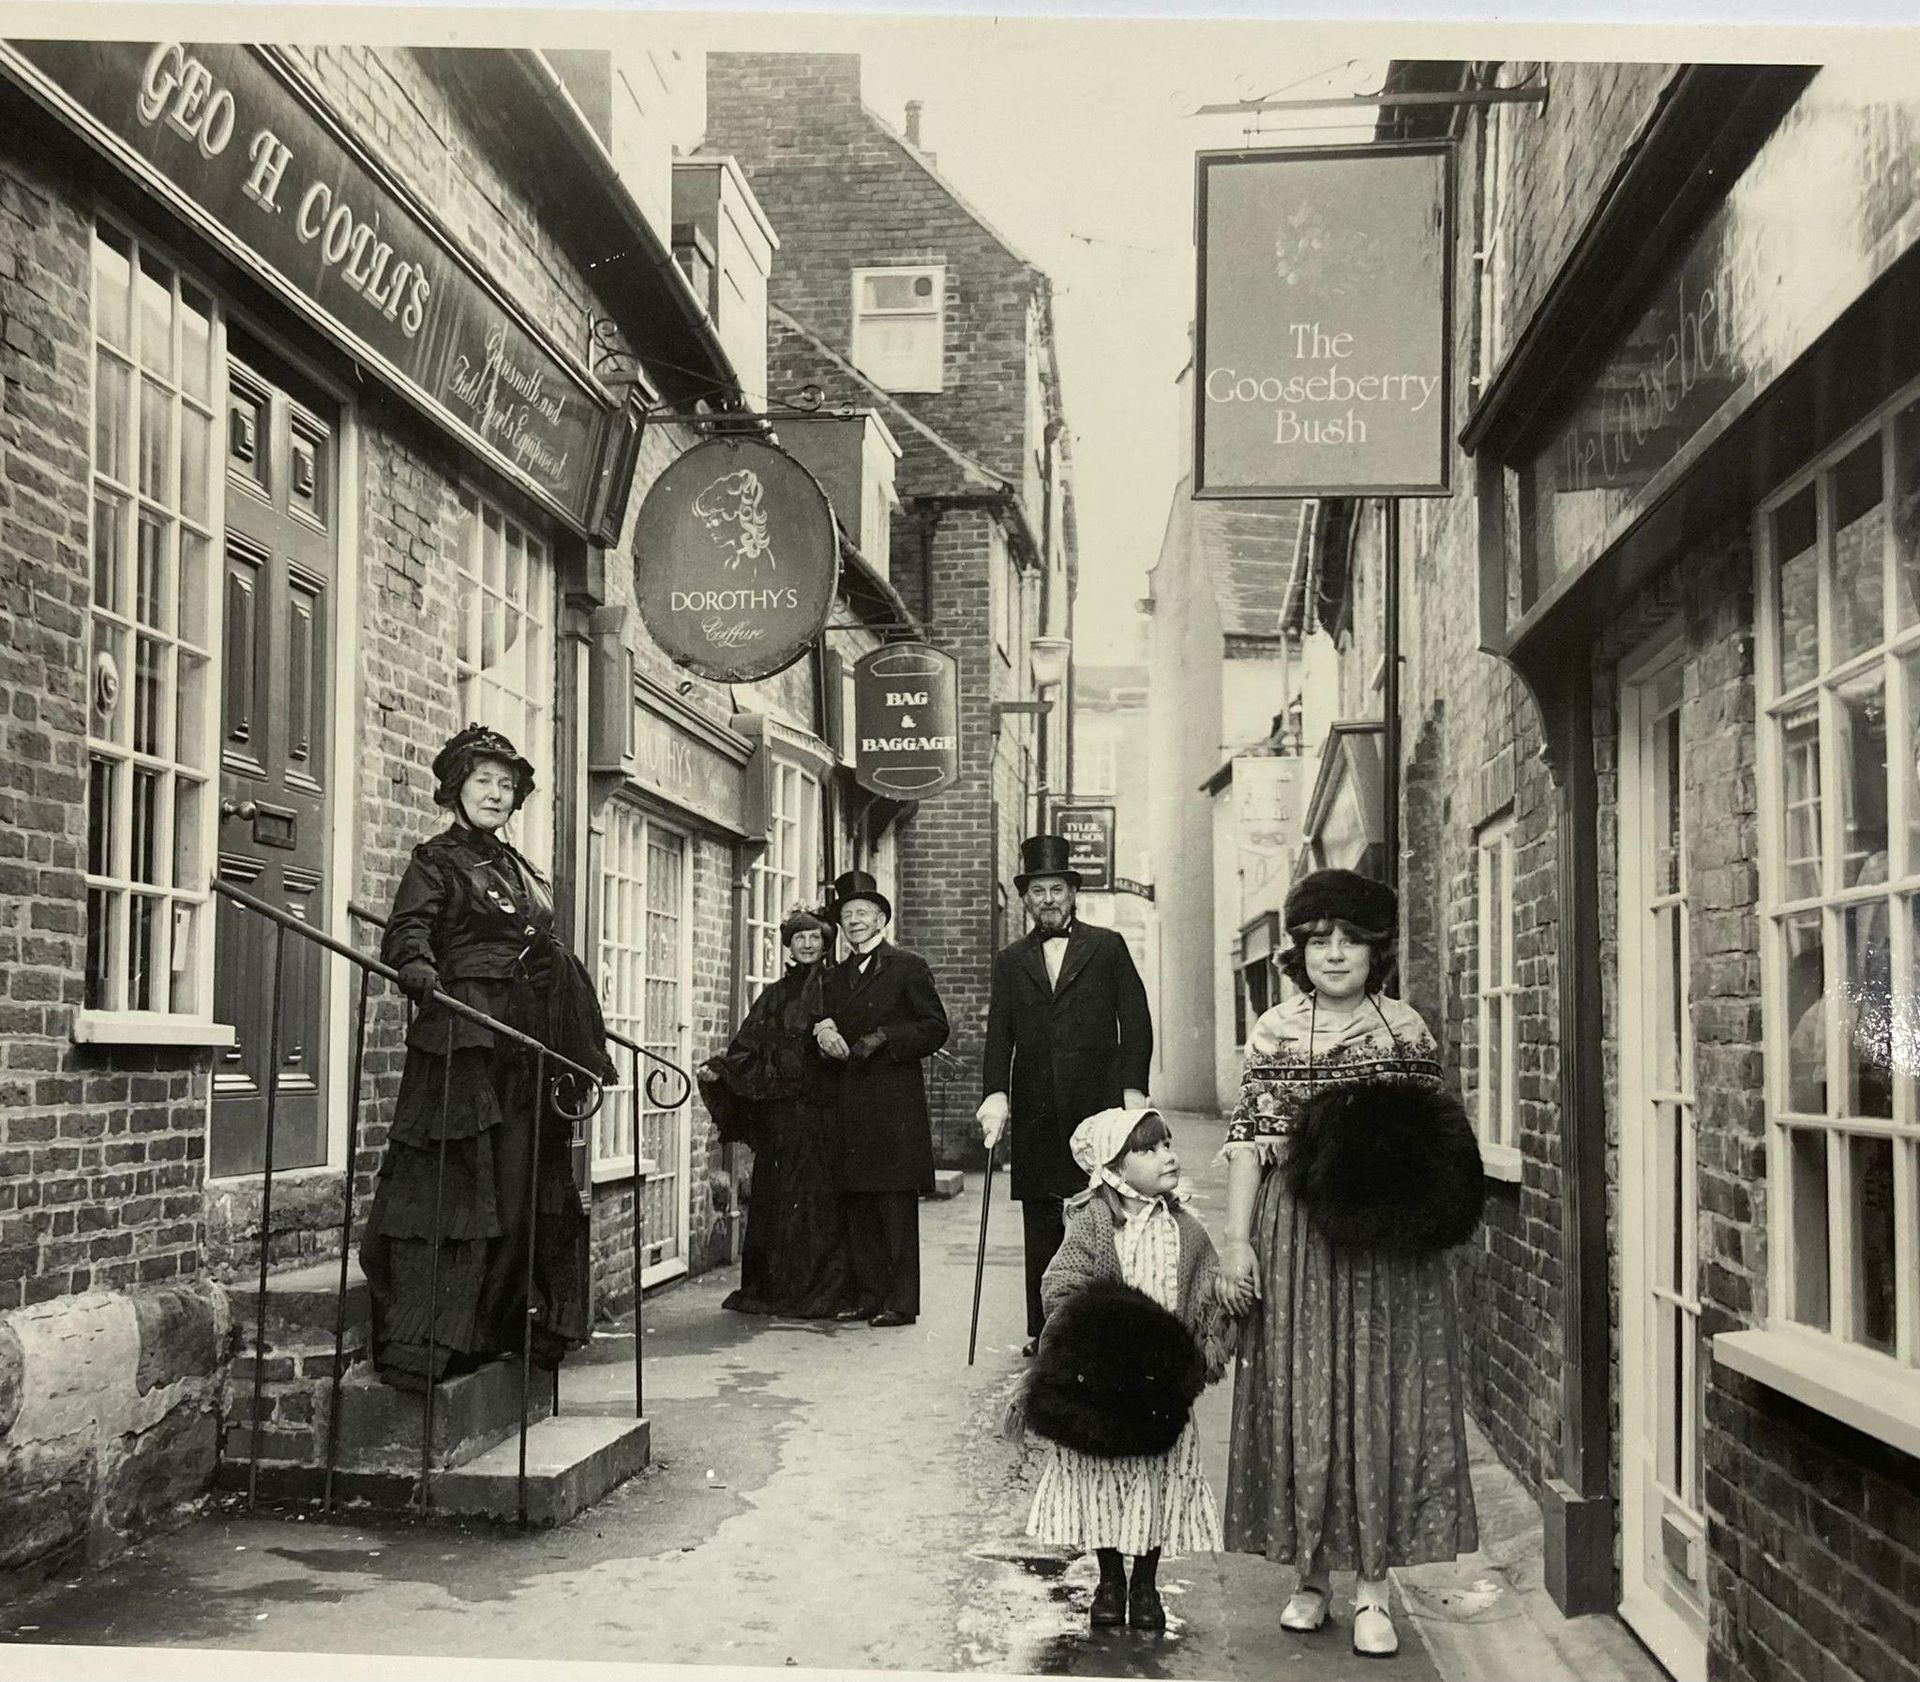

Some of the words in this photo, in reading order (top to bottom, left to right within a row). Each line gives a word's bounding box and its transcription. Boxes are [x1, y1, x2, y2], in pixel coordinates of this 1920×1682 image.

[1289, 322, 1354, 359] The
[485, 325, 543, 408] Gunsmith
[539, 394, 566, 427] and
[1205, 365, 1440, 412] Gooseberry
[448, 351, 496, 409] Field
[512, 405, 569, 480] Equipment
[1273, 408, 1368, 445] Bush
[670, 588, 798, 612] DOROTHY'S
[700, 616, 766, 648] Coiffure
[886, 691, 929, 707] BAG
[901, 714, 917, 729] &
[862, 735, 957, 752] BAGGAGE
